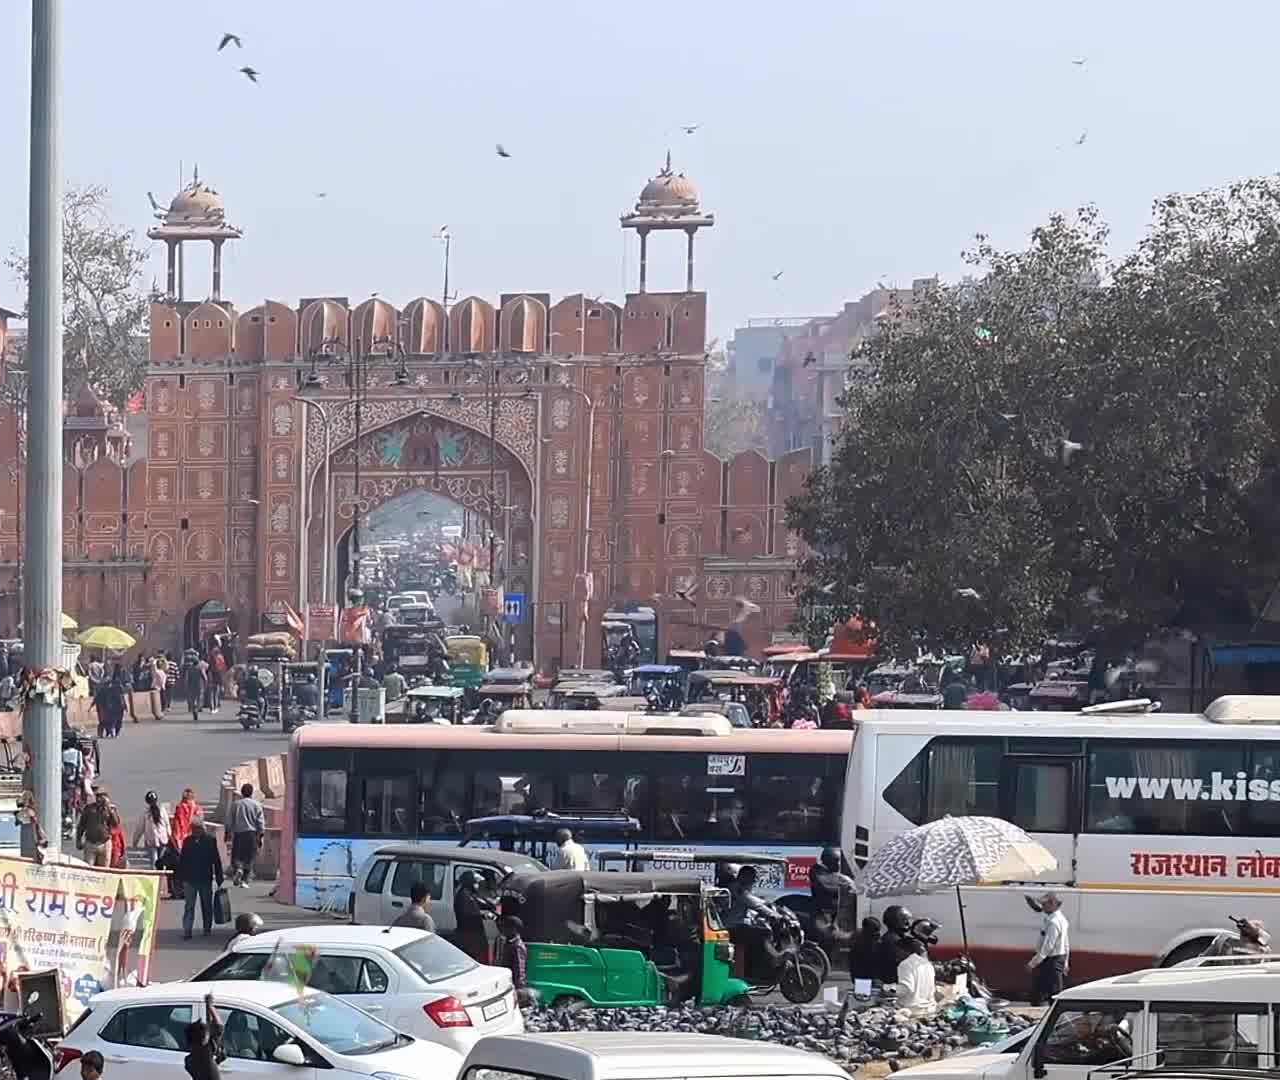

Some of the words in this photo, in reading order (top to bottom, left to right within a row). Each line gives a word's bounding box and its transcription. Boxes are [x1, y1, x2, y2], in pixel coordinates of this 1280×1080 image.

[1130, 853, 1227, 876] राजस्थान
[26, 885, 70, 919] राम
[75, 893, 114, 922] कथ
